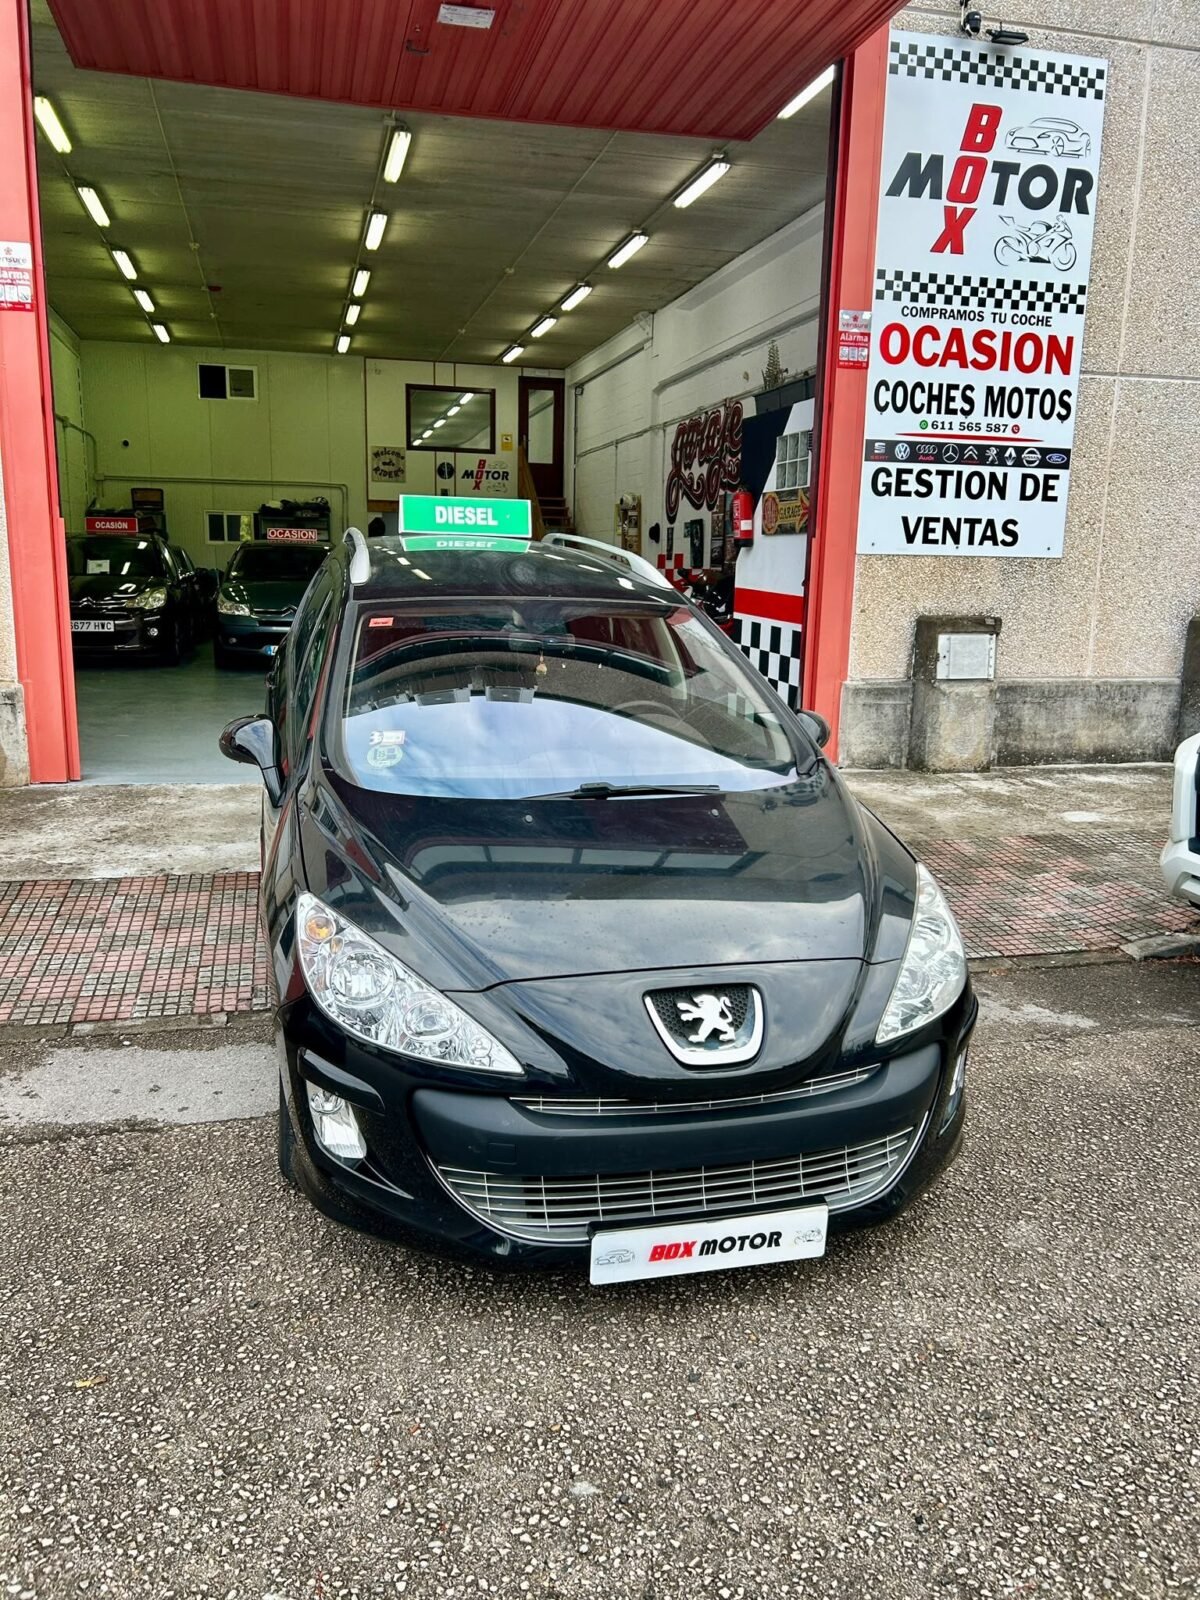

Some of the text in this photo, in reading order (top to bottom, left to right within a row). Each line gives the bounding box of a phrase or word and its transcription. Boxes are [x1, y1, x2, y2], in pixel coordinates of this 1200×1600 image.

[885, 152, 1094, 215] MOTOR
[930, 103, 1003, 255] BOX
[901, 306, 1052, 327] COMPRAMOS TU COCHE
[840, 332, 868, 342] Alarma
[879, 322, 1074, 375] OCASION
[874, 379, 1072, 421] COCHES MOTOS
[931, 421, 1009, 433] 611 565 587
[461, 470, 509, 480] MOTOR
[871, 467, 1060, 502] GESTION DE
[435, 505, 498, 526] DIESEL
[269, 529, 316, 539] OCASION
[901, 516, 1019, 547] VENTAS
[648, 1231, 782, 1262] BOX MOTOR
